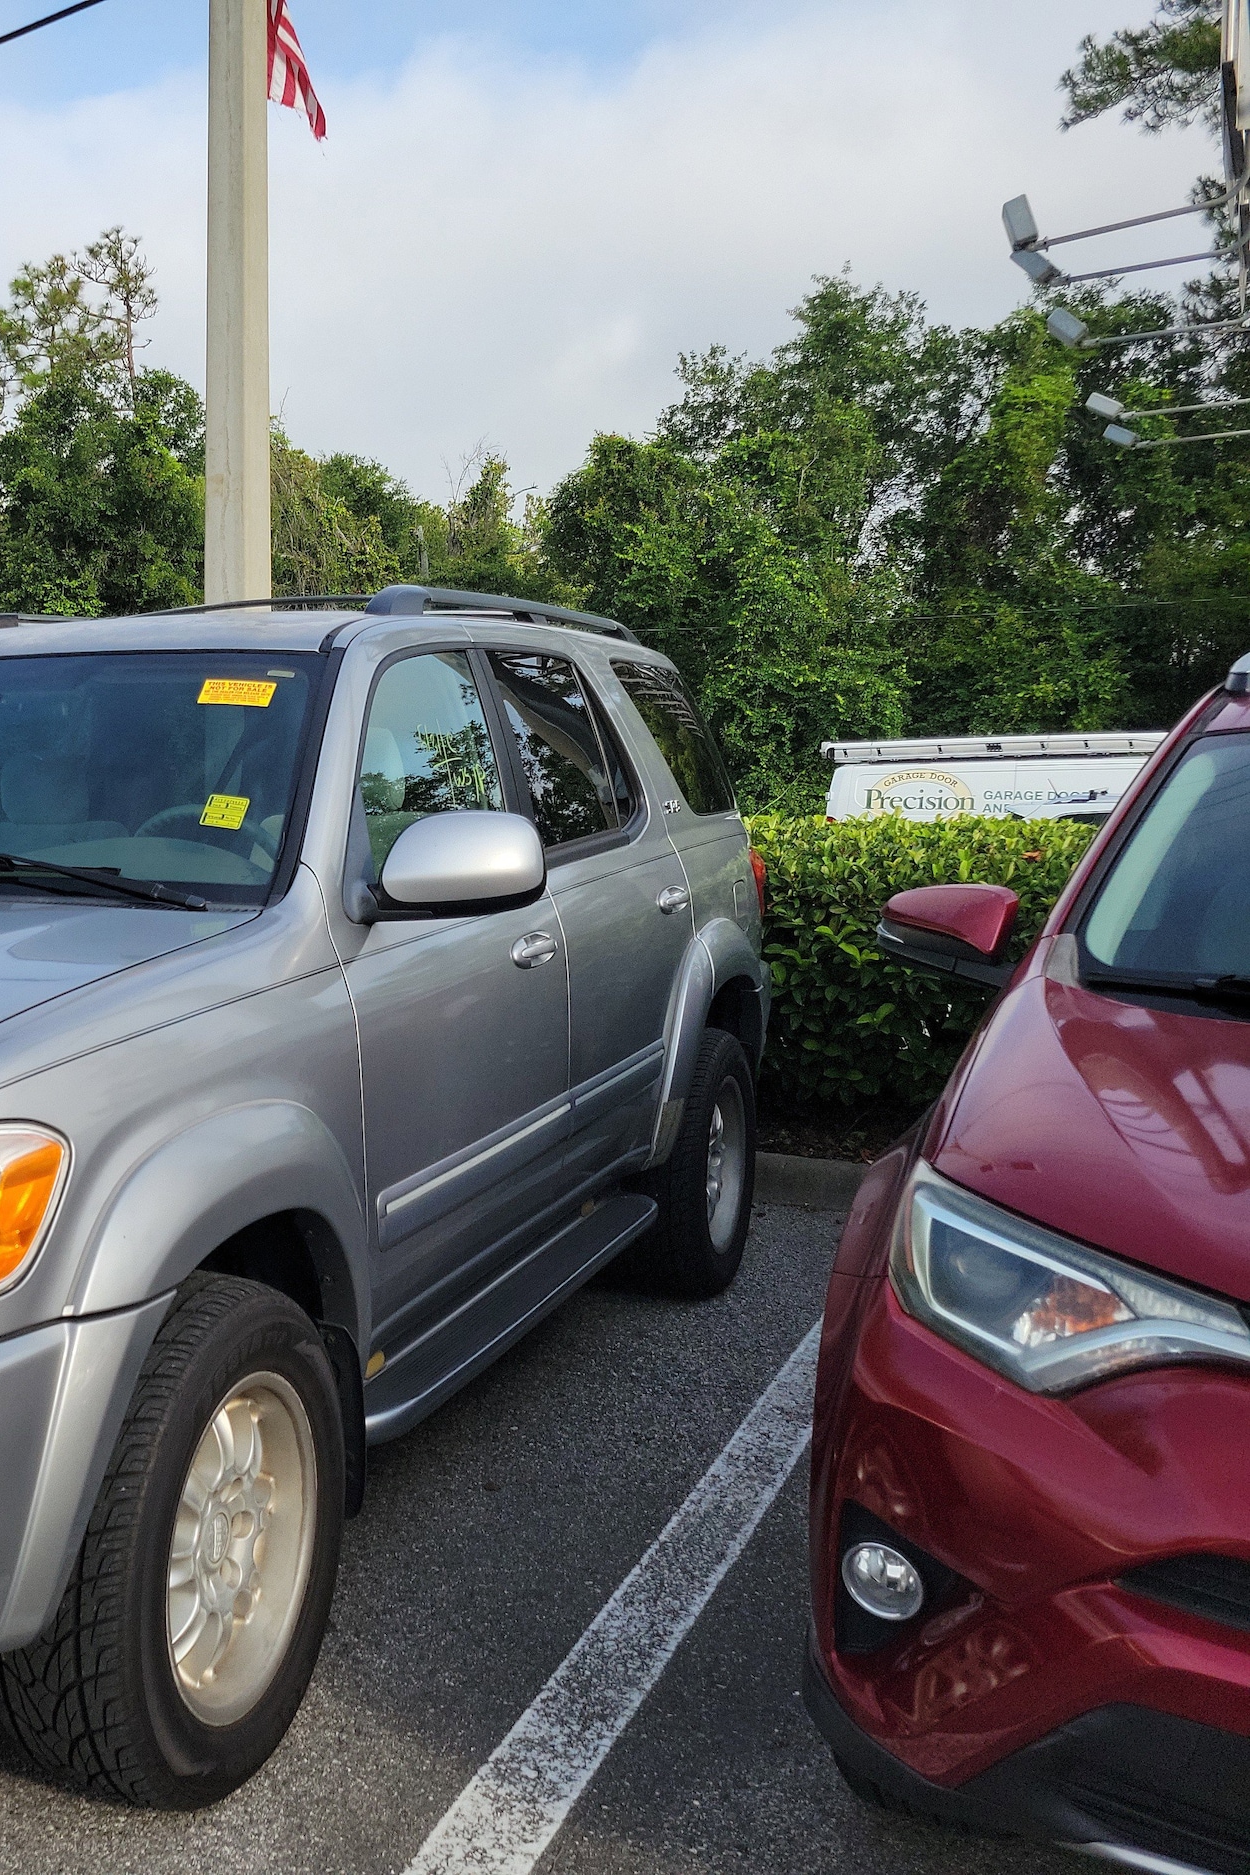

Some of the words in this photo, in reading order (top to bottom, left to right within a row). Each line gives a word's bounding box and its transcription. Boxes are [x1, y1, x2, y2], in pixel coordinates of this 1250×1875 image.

[883, 772, 926, 787] GARAGE
[929, 772, 958, 788] DOOR
[862, 788, 977, 811] Precision
[983, 790, 1043, 801] GARAGE
[1047, 790, 1090, 801] DO
